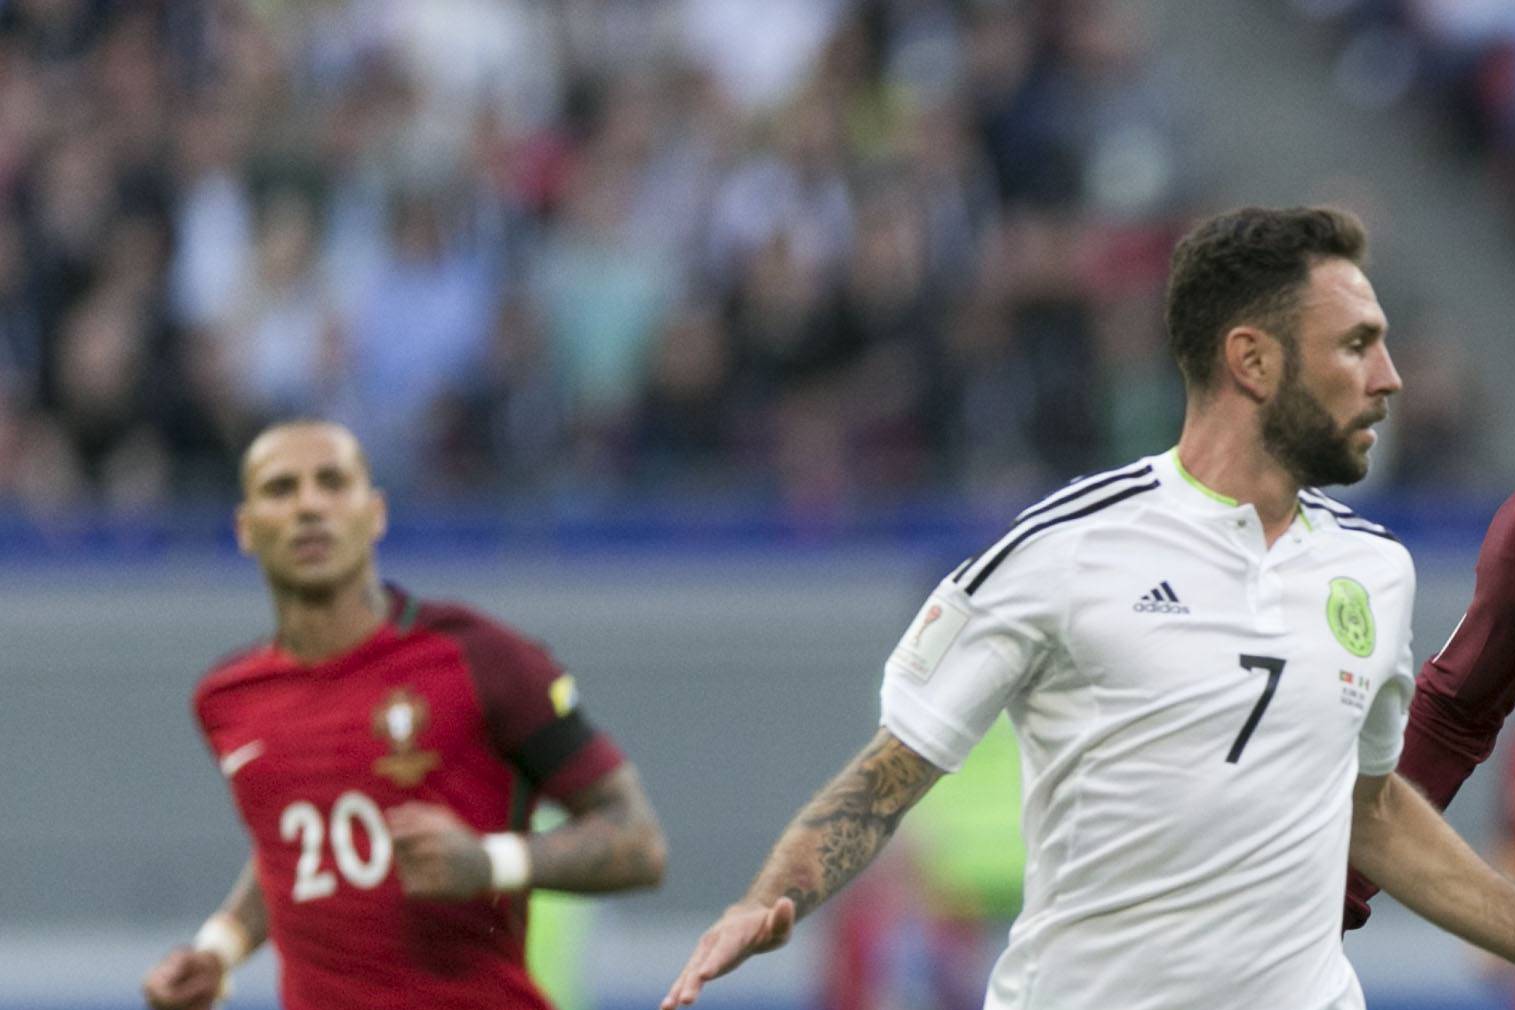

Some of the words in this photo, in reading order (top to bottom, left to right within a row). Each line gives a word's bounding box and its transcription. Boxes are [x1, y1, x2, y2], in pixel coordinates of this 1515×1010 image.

[1132, 601, 1190, 614] adidas
[1225, 653, 1287, 764] 7
[279, 790, 393, 904] 20
